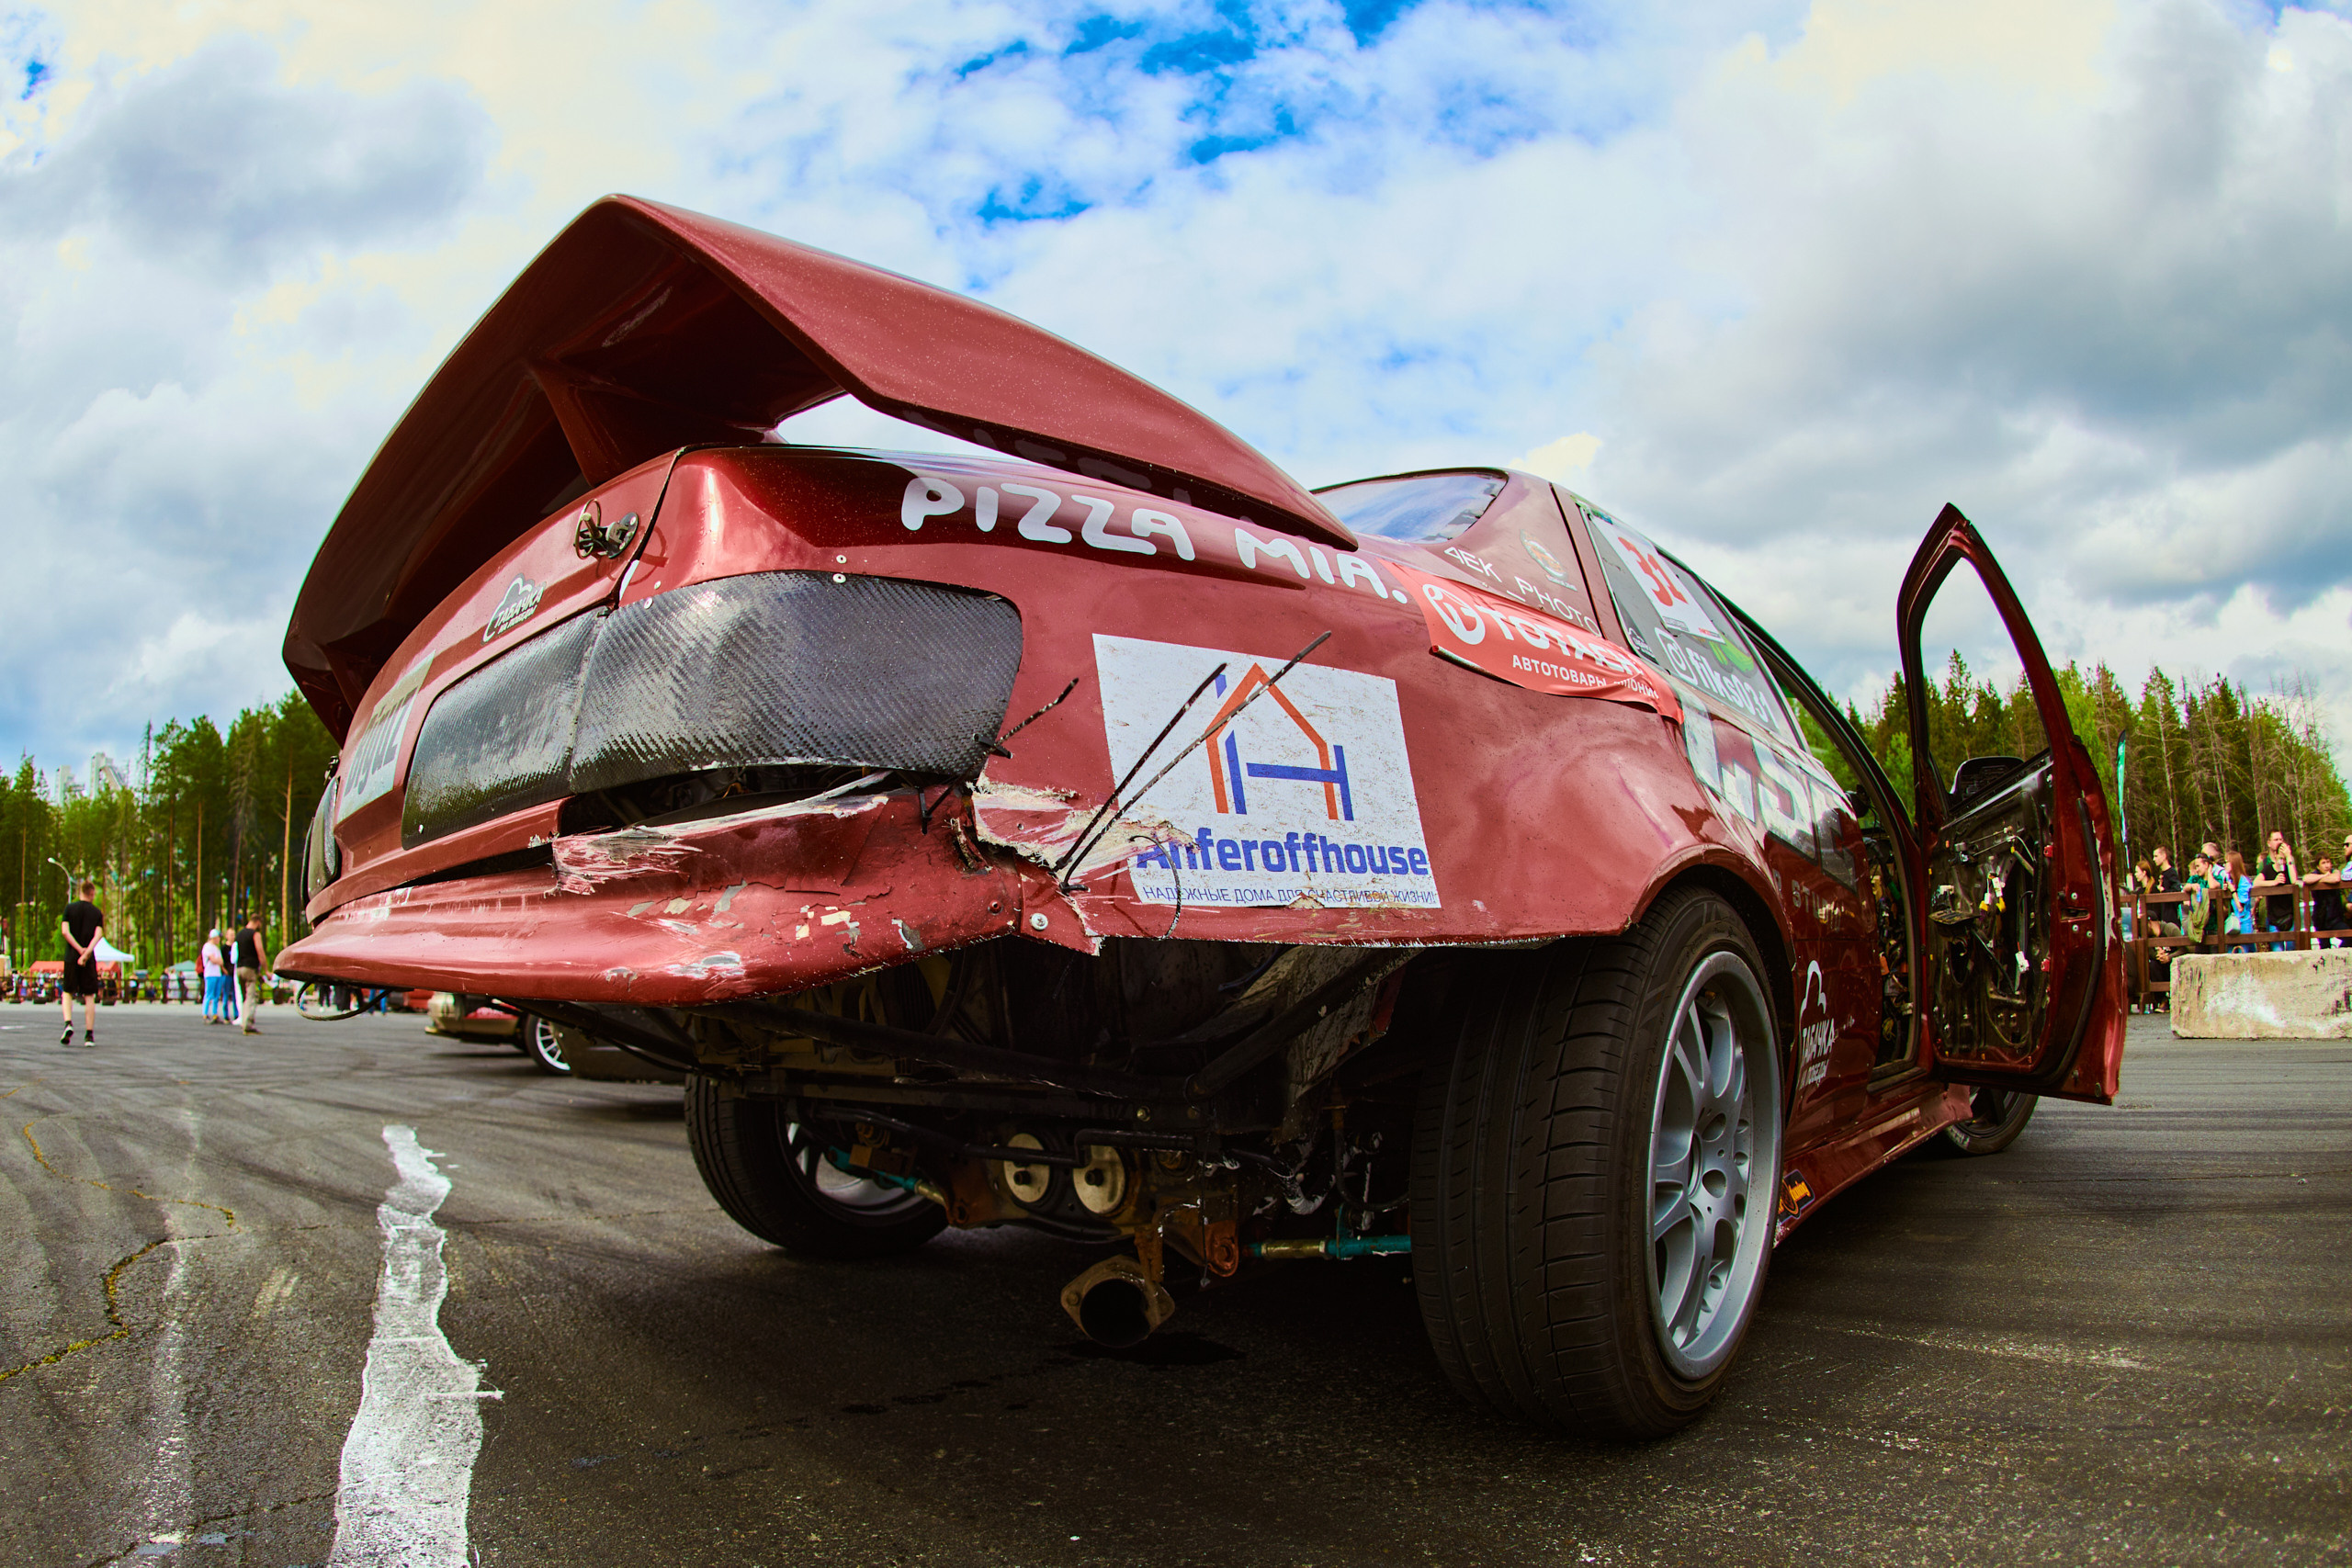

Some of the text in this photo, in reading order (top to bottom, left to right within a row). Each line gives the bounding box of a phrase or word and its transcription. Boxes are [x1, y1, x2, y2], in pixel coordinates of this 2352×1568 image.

[901, 477, 1408, 604] PIZZA MIA.
[1618, 536, 1689, 607] 31
[1512, 655, 1607, 687] АВТОТОВАРЫ
[1235, 889, 1275, 903] ДОМА
[1308, 888, 1389, 903] СЧАСТЛИВОЙ
[1391, 890, 1436, 904] ЖИЗНИ!
